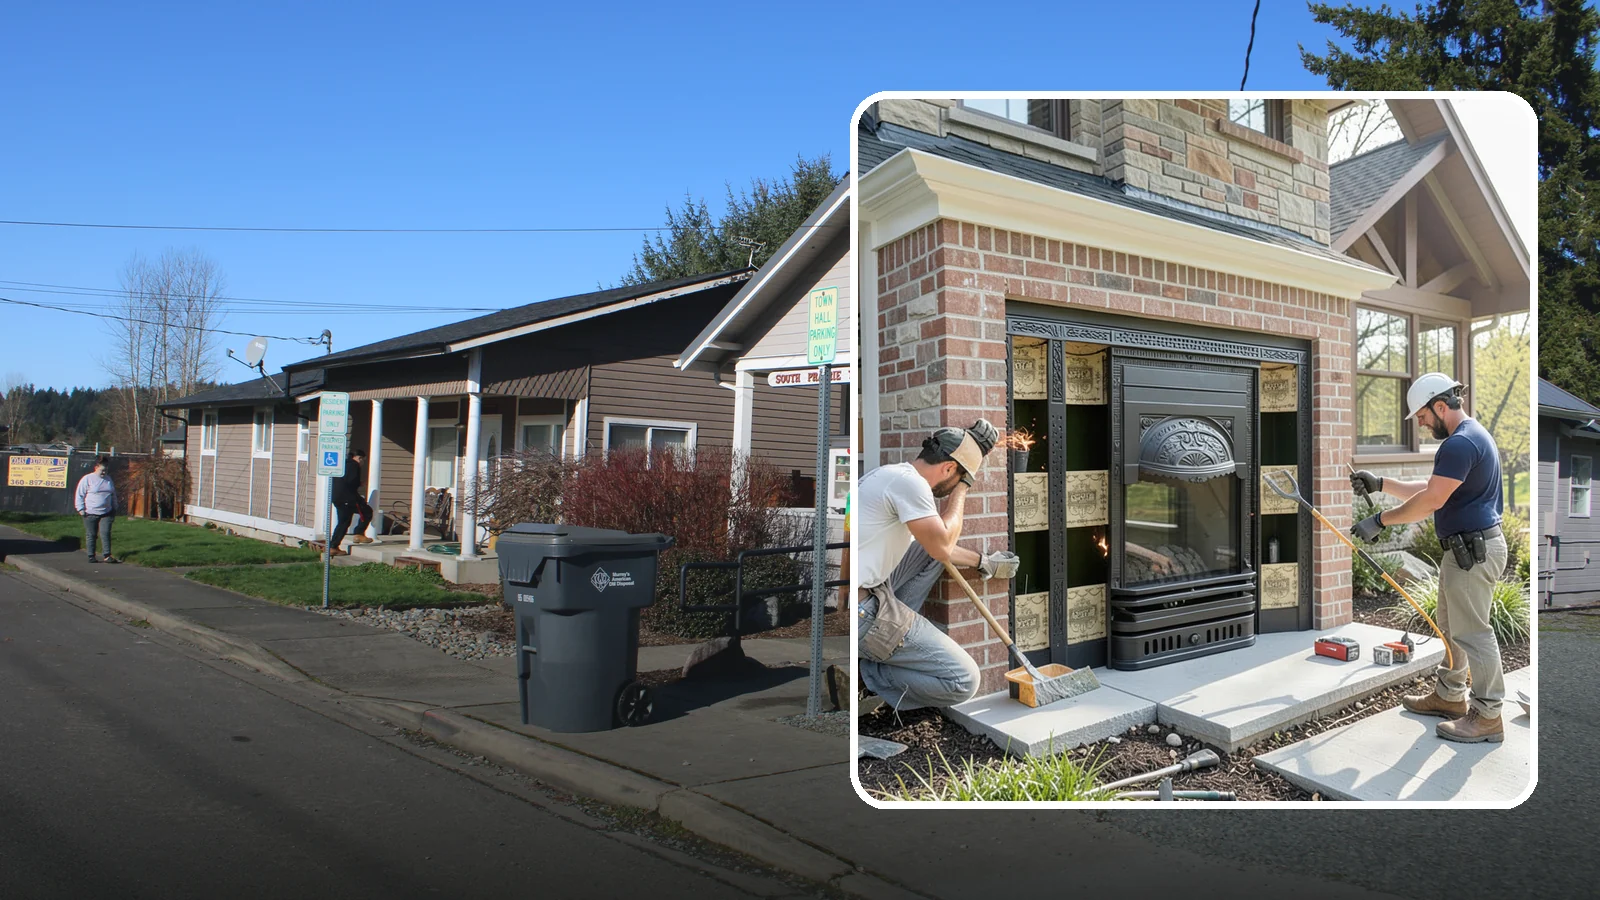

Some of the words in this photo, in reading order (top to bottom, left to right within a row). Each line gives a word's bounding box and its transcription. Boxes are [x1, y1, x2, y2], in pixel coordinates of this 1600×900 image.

[815, 294, 833, 307] TOWN
[814, 312, 831, 324] HALL
[810, 326, 836, 340] PARKING
[813, 344, 831, 357] ONLY
[775, 374, 801, 384] SOUTH
[807, 370, 842, 383] PRIE
